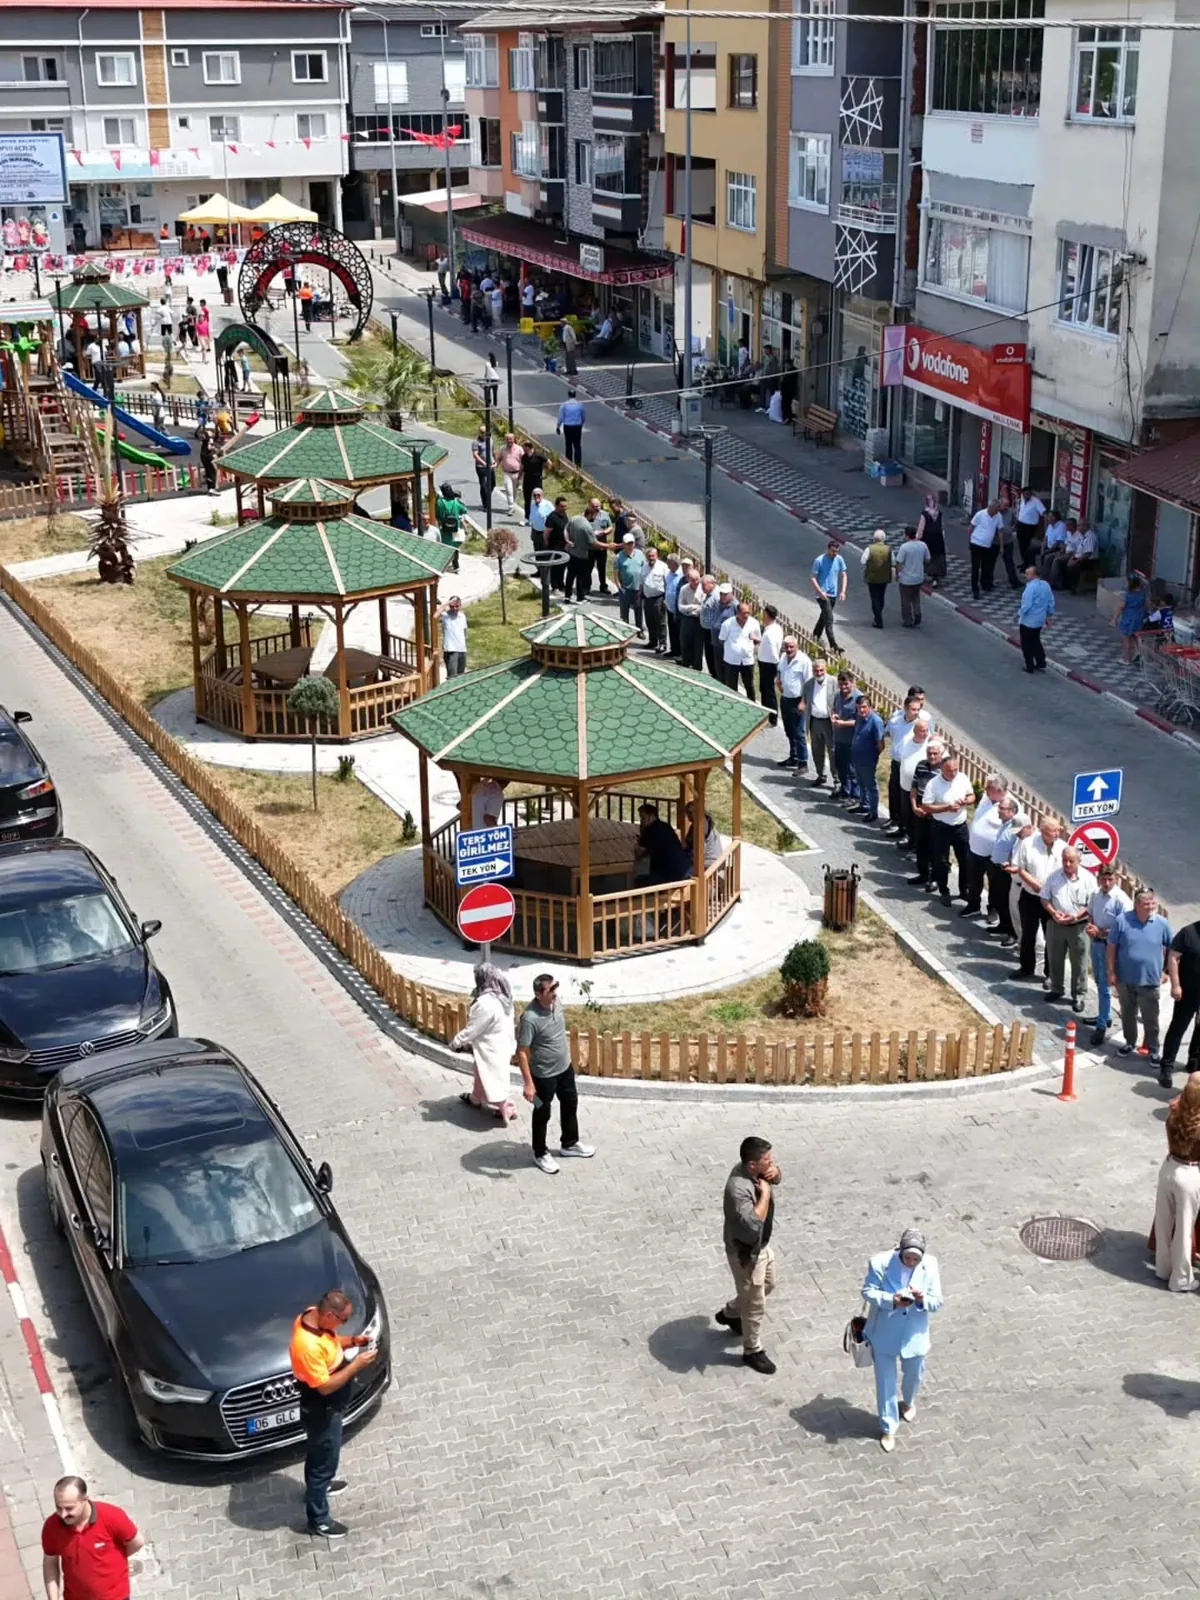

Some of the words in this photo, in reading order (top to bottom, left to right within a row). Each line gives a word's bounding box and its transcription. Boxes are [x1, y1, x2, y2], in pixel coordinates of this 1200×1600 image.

[922, 351, 969, 385] vodafone
[1078, 804, 1095, 815] TEK
[462, 833, 486, 846] TERS
[488, 830, 507, 841] YÖN
[460, 841, 510, 858] GİRİLMEZ
[461, 867, 478, 876] TEK
[480, 862, 497, 873] YÖN
[255, 1418, 269, 1430] 06
[275, 1410, 296, 1425] GLC
